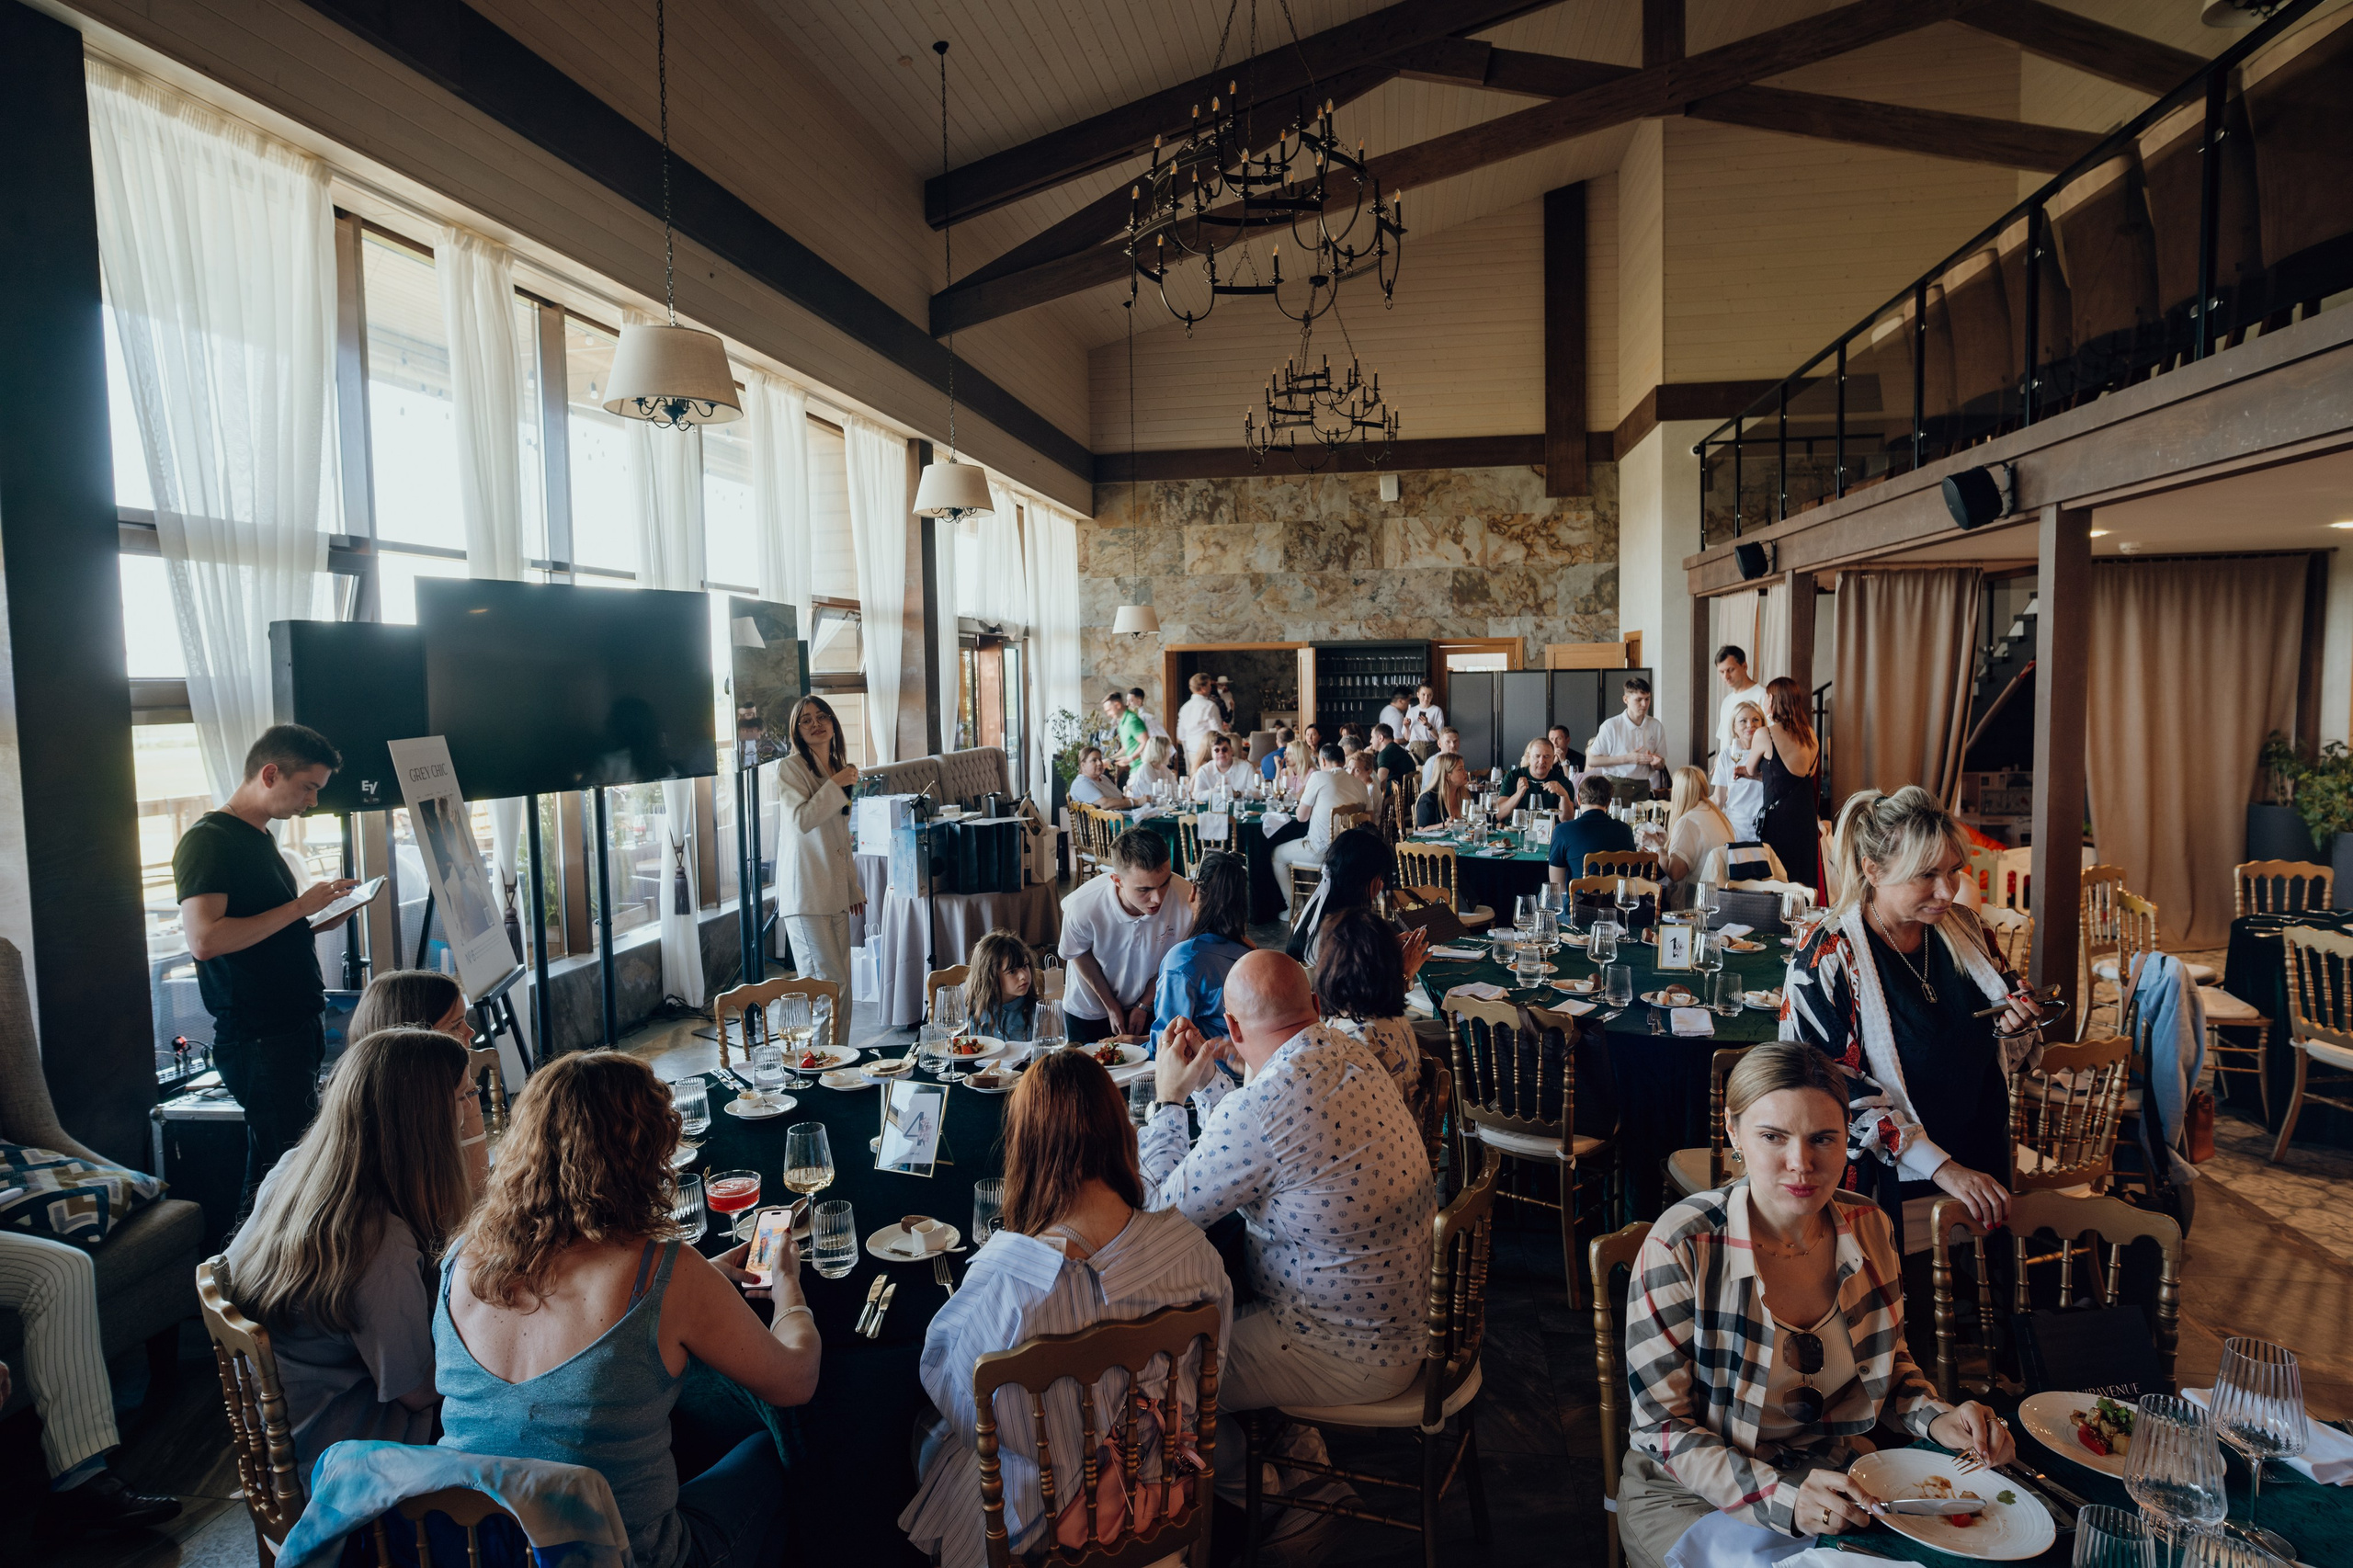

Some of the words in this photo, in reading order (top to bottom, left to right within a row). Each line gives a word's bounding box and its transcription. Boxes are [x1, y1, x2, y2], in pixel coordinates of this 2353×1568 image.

[409, 766, 431, 782] GREY
[431, 763, 449, 778] CHIC
[361, 779, 379, 795] EV
[1537, 824, 1545, 838] 3
[1669, 937, 1678, 958] 1
[904, 1111, 924, 1146] 4
